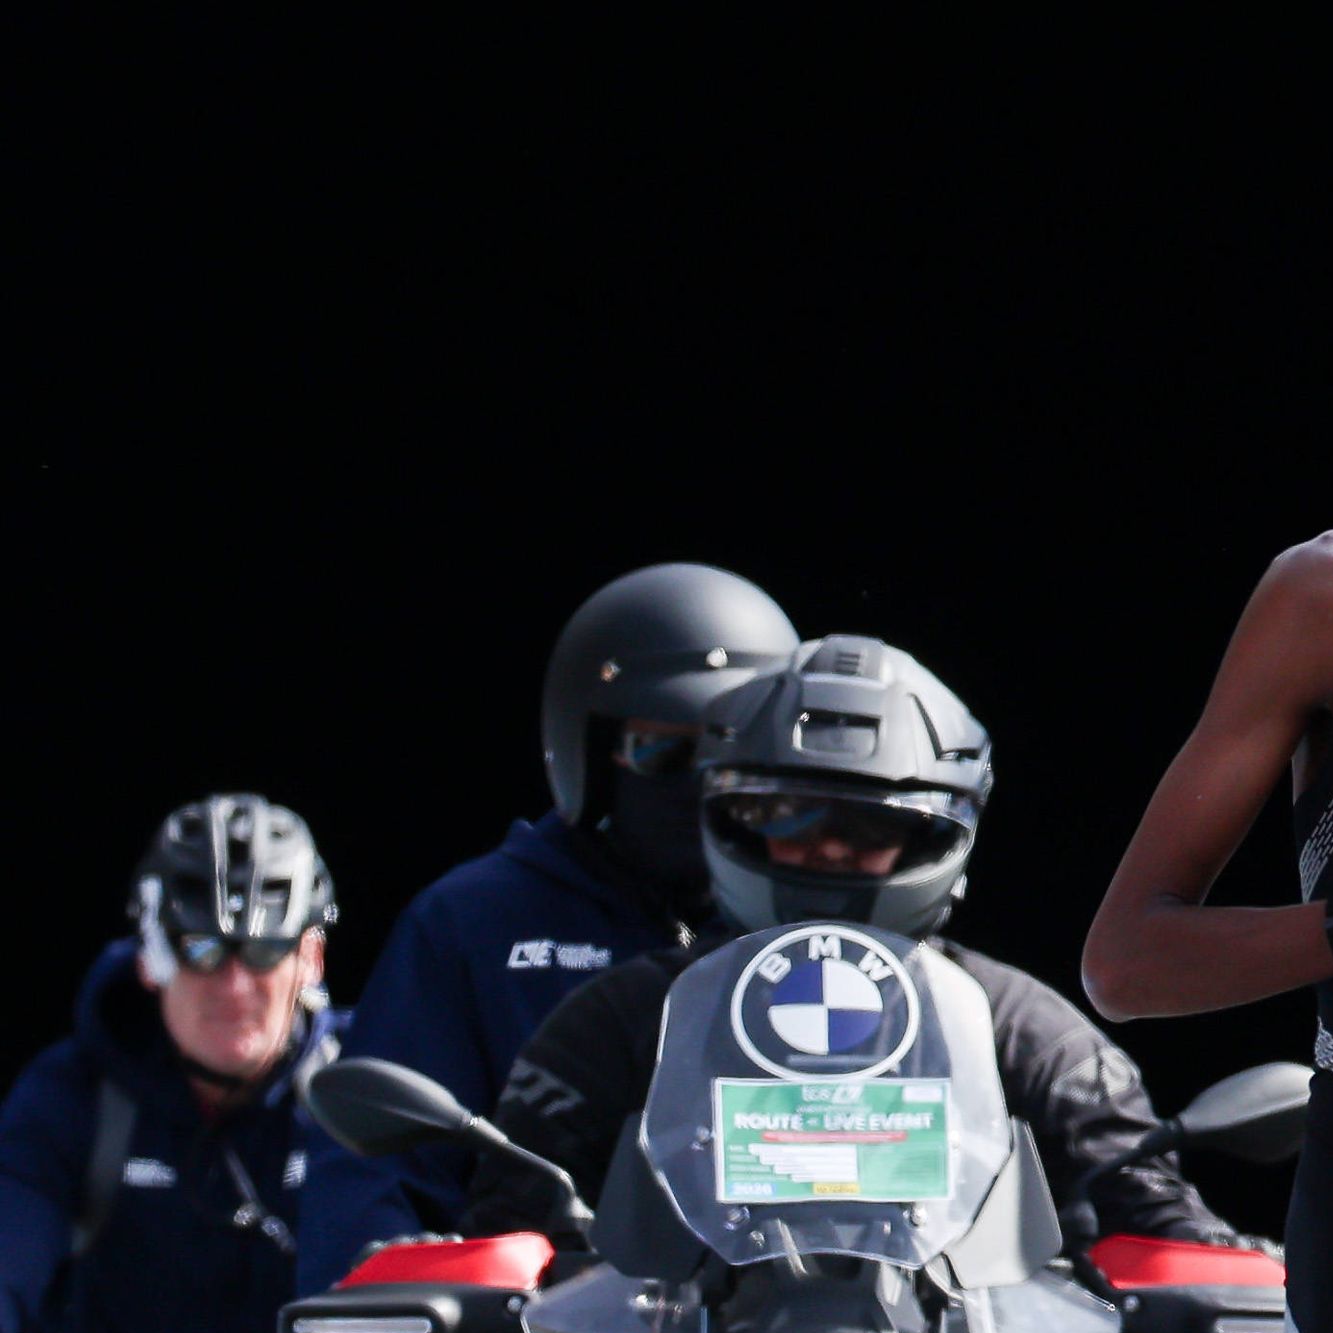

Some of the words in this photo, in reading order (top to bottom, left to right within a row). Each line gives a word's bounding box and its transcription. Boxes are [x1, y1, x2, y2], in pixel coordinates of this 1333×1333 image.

[757, 935, 894, 984] BMW
[734, 1112, 802, 1130] ROUTE
[822, 1112, 867, 1131] LIVE
[869, 1112, 933, 1130] EVENT
